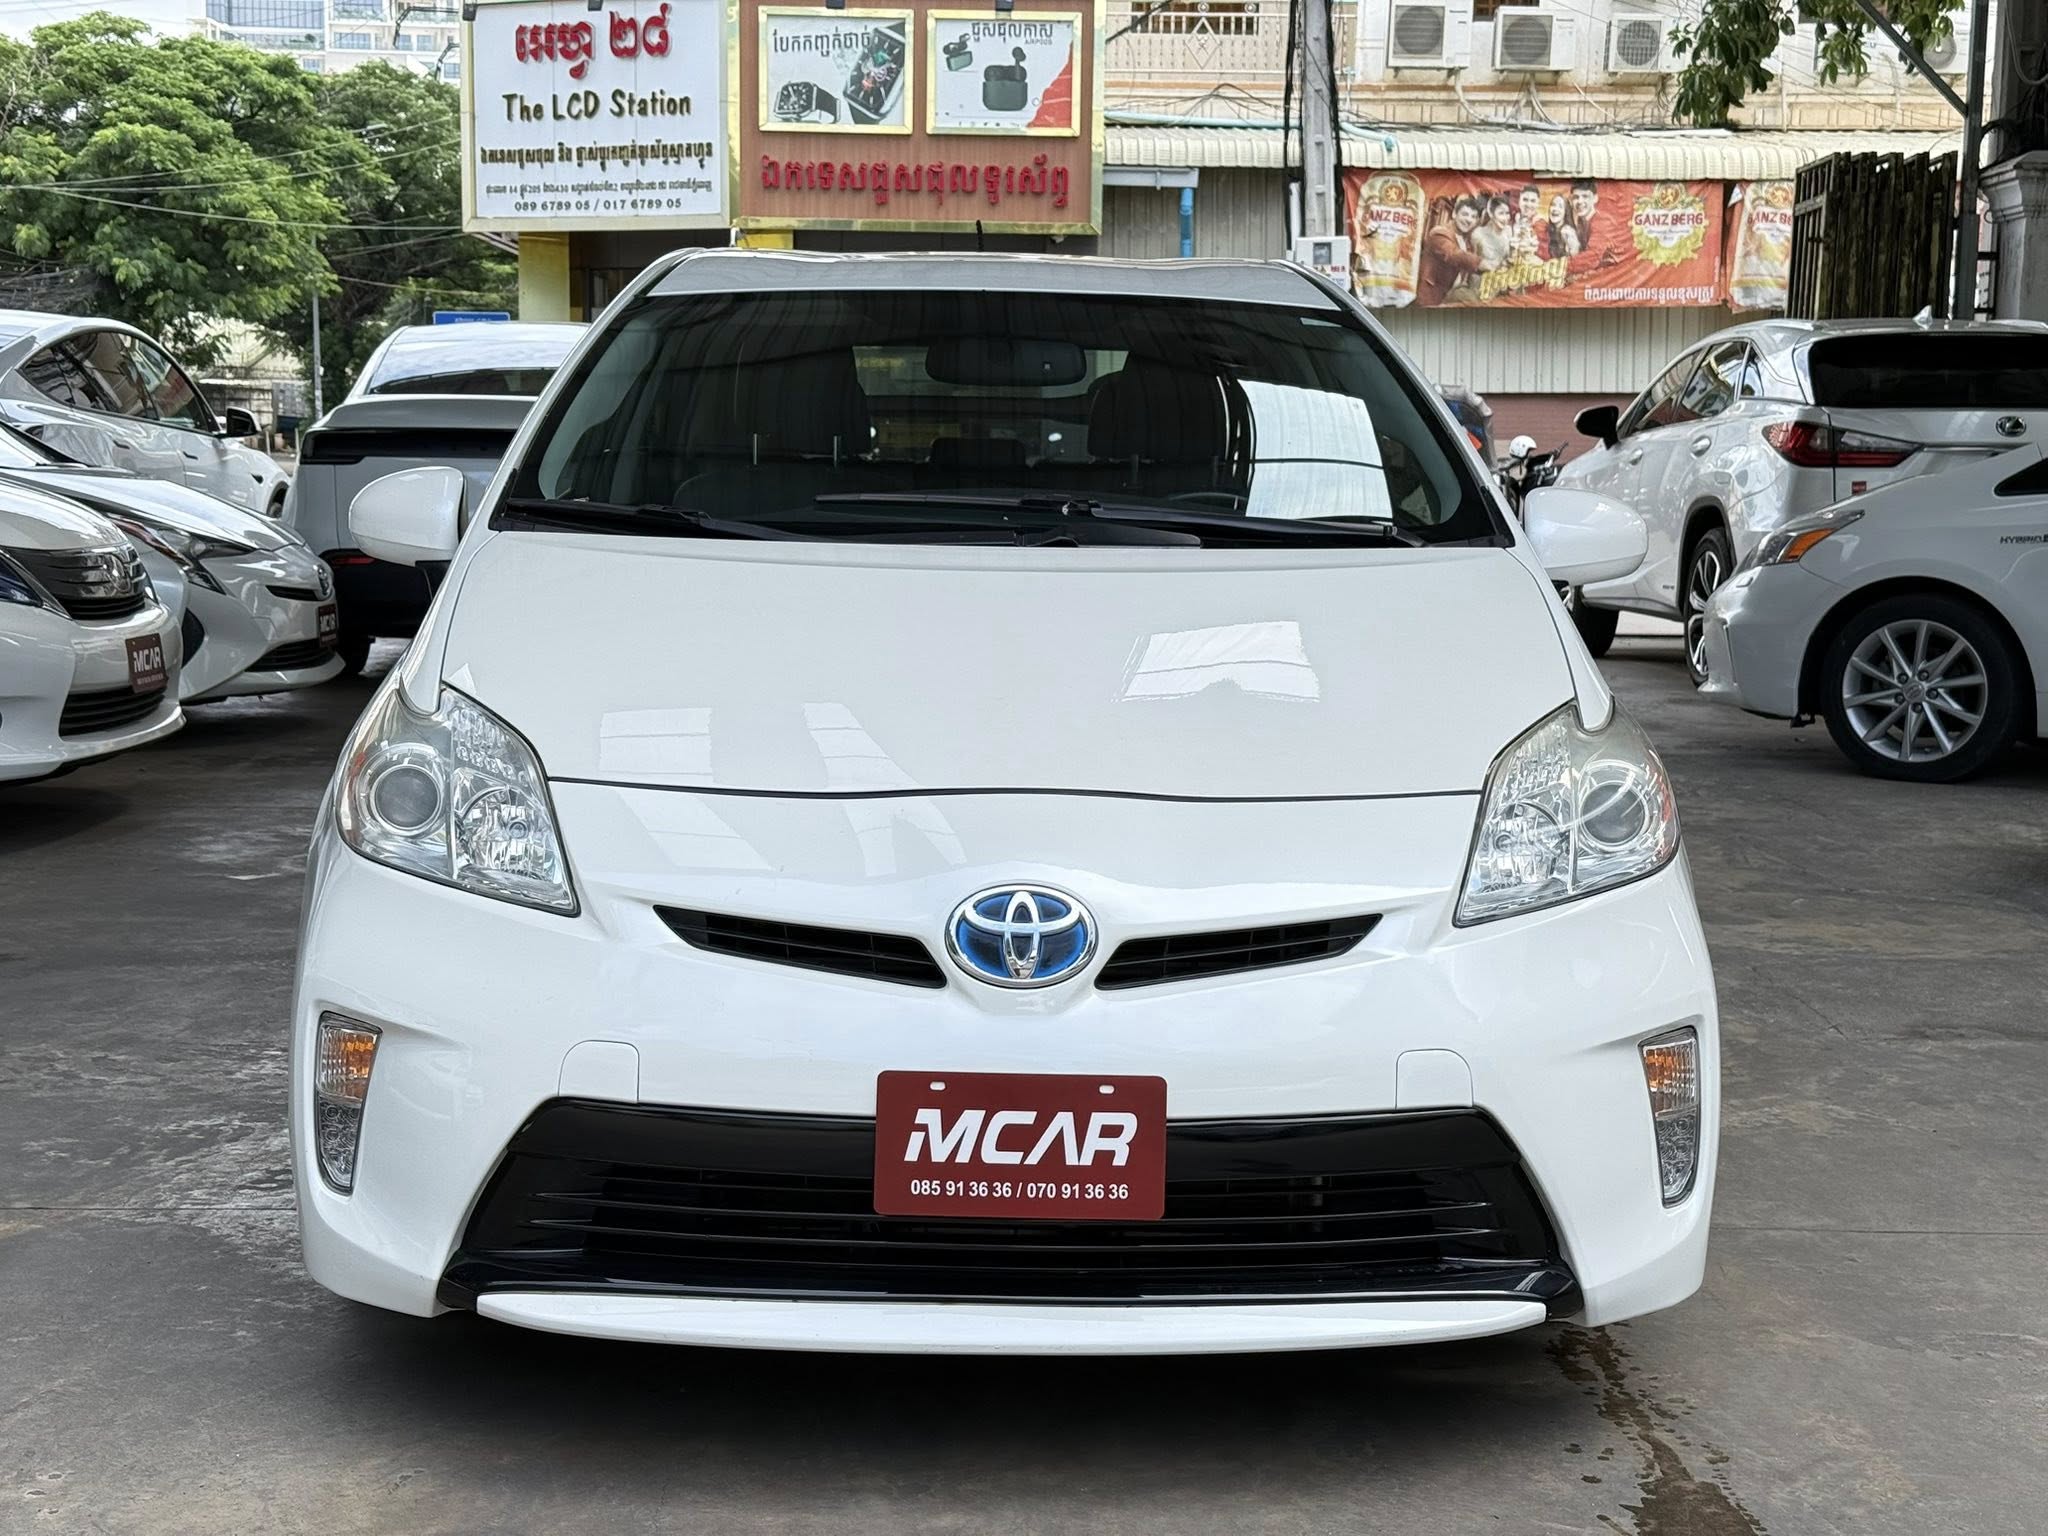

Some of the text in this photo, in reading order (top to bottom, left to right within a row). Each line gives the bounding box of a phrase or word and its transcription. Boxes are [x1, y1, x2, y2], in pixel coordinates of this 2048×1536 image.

[609, 3, 672, 58] ២៨
[502, 89, 692, 122] The LCD Station
[514, 201, 537, 212] 089
[541, 200, 571, 211] 6789
[575, 200, 590, 210] 05
[603, 199, 626, 210] 017
[631, 199, 662, 210] 6789
[666, 198, 682, 209] 05
[132, 646, 162, 673] MCAR
[904, 1108, 1138, 1167] MCAR
[910, 1179, 1129, 1200] 085 91 36 36 / 070 91 36 36
